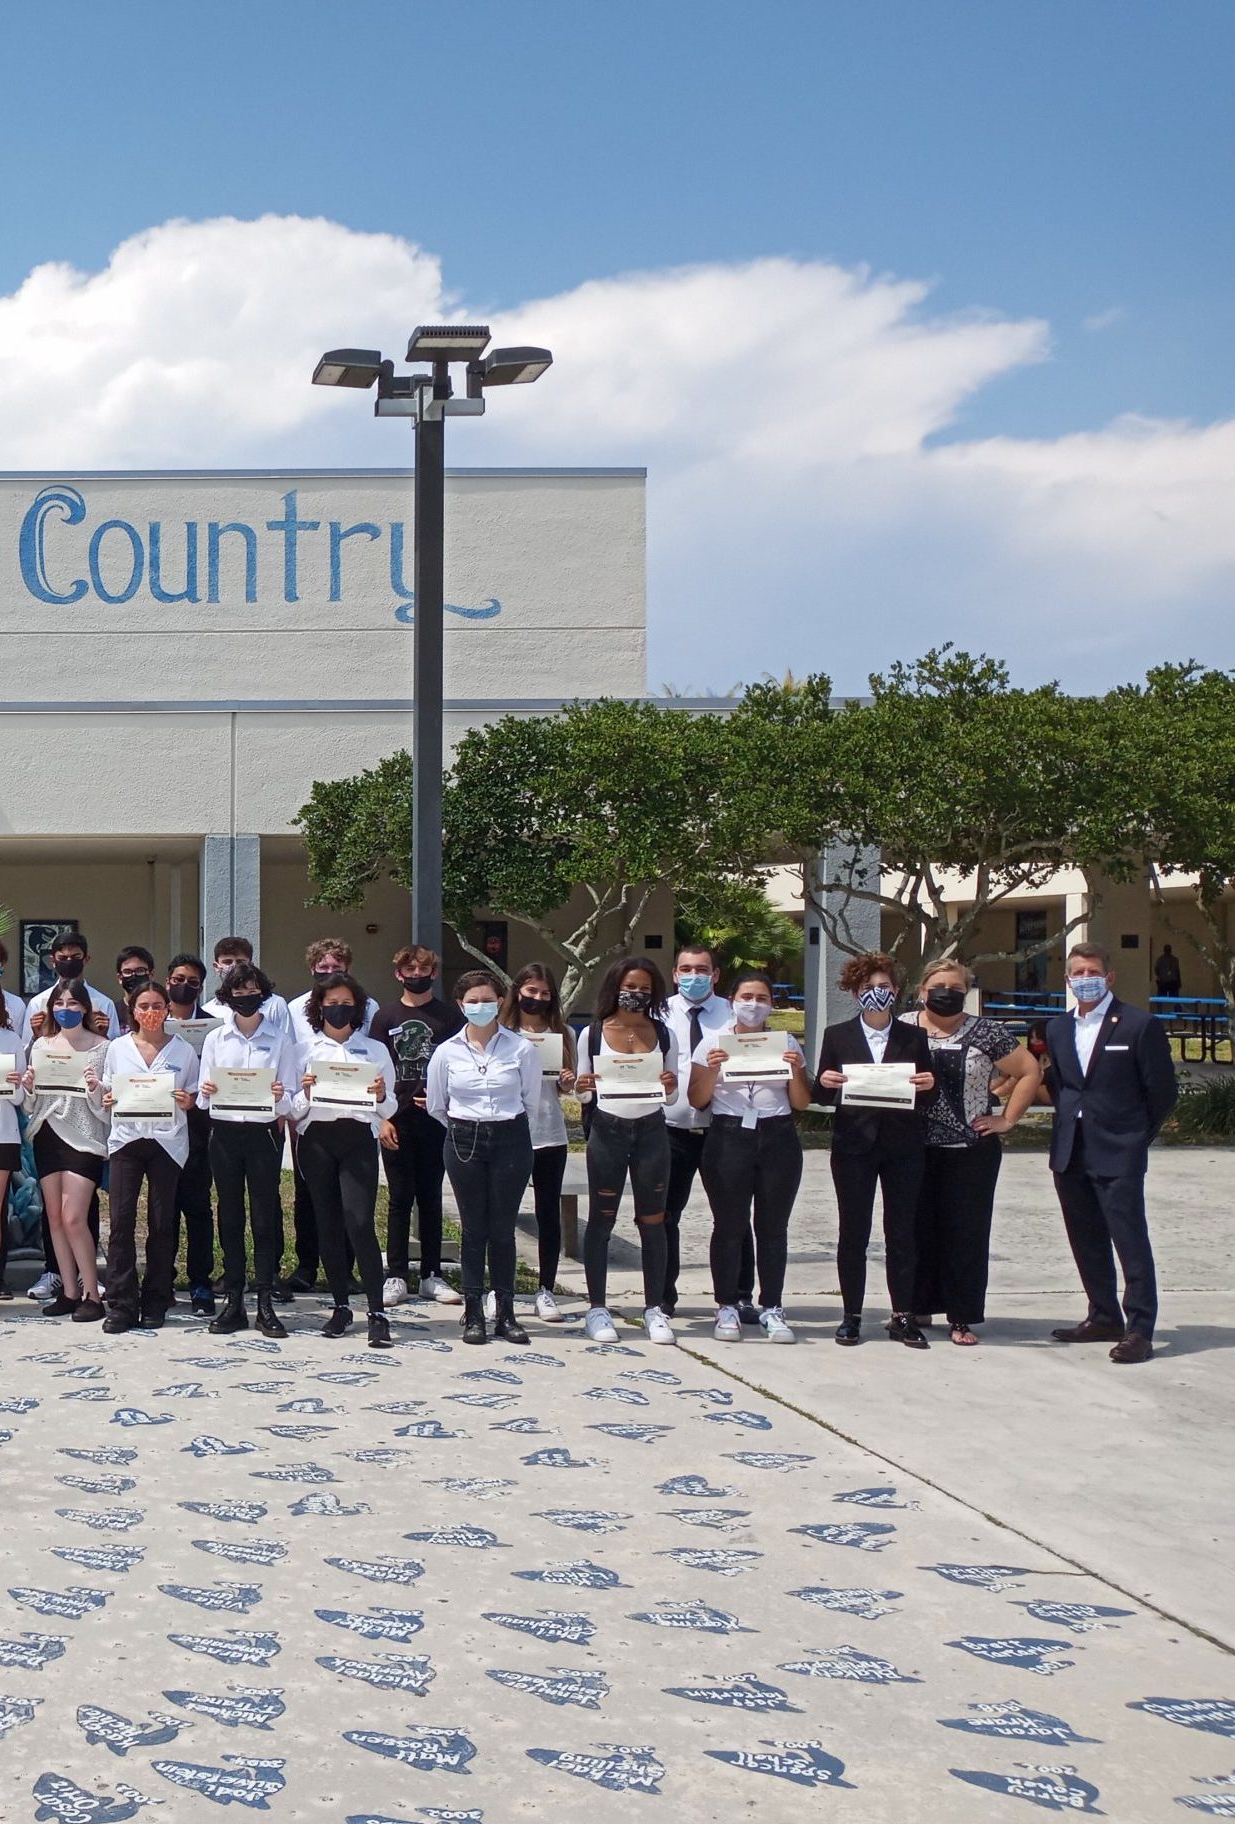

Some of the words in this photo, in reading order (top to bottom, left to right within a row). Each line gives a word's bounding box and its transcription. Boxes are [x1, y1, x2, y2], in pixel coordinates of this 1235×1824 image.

[19, 485, 502, 624] Country
[539, 1570, 611, 1580] Lakey
[647, 1612, 707, 1622] Lynch
[537, 1624, 581, 1639] Phil
[960, 1638, 1021, 1651] Brett
[783, 1660, 896, 1671] Christopher
[809, 1668, 902, 1680] Blakely
[335, 1668, 423, 1687] Michael
[501, 1680, 596, 1704] Jennifer
[556, 1682, 607, 1699] Leigh
[732, 1698, 781, 1708] Jeff
[79, 1706, 143, 1738] Richter
[966, 1717, 1039, 1728] Krane
[78, 1719, 139, 1748] Kasey
[995, 1726, 1070, 1738] Jaron
[350, 1733, 439, 1753] Rossen
[394, 1750, 461, 1765] Matt
[558, 1752, 665, 1779] Shelling
[736, 1751, 810, 1769] Schell
[154, 1762, 283, 1793] Silverstein
[545, 1761, 653, 1787] Michael
[730, 1760, 832, 1781] Spencer
[49, 1781, 100, 1809] Ortiz
[203, 1785, 262, 1801] Jodi
[1004, 1776, 1087, 1797] Cohen
[1008, 1785, 1086, 1808] Barry
[33, 1791, 92, 1824] Cesar
[427, 1808, 481, 1819] 2002
